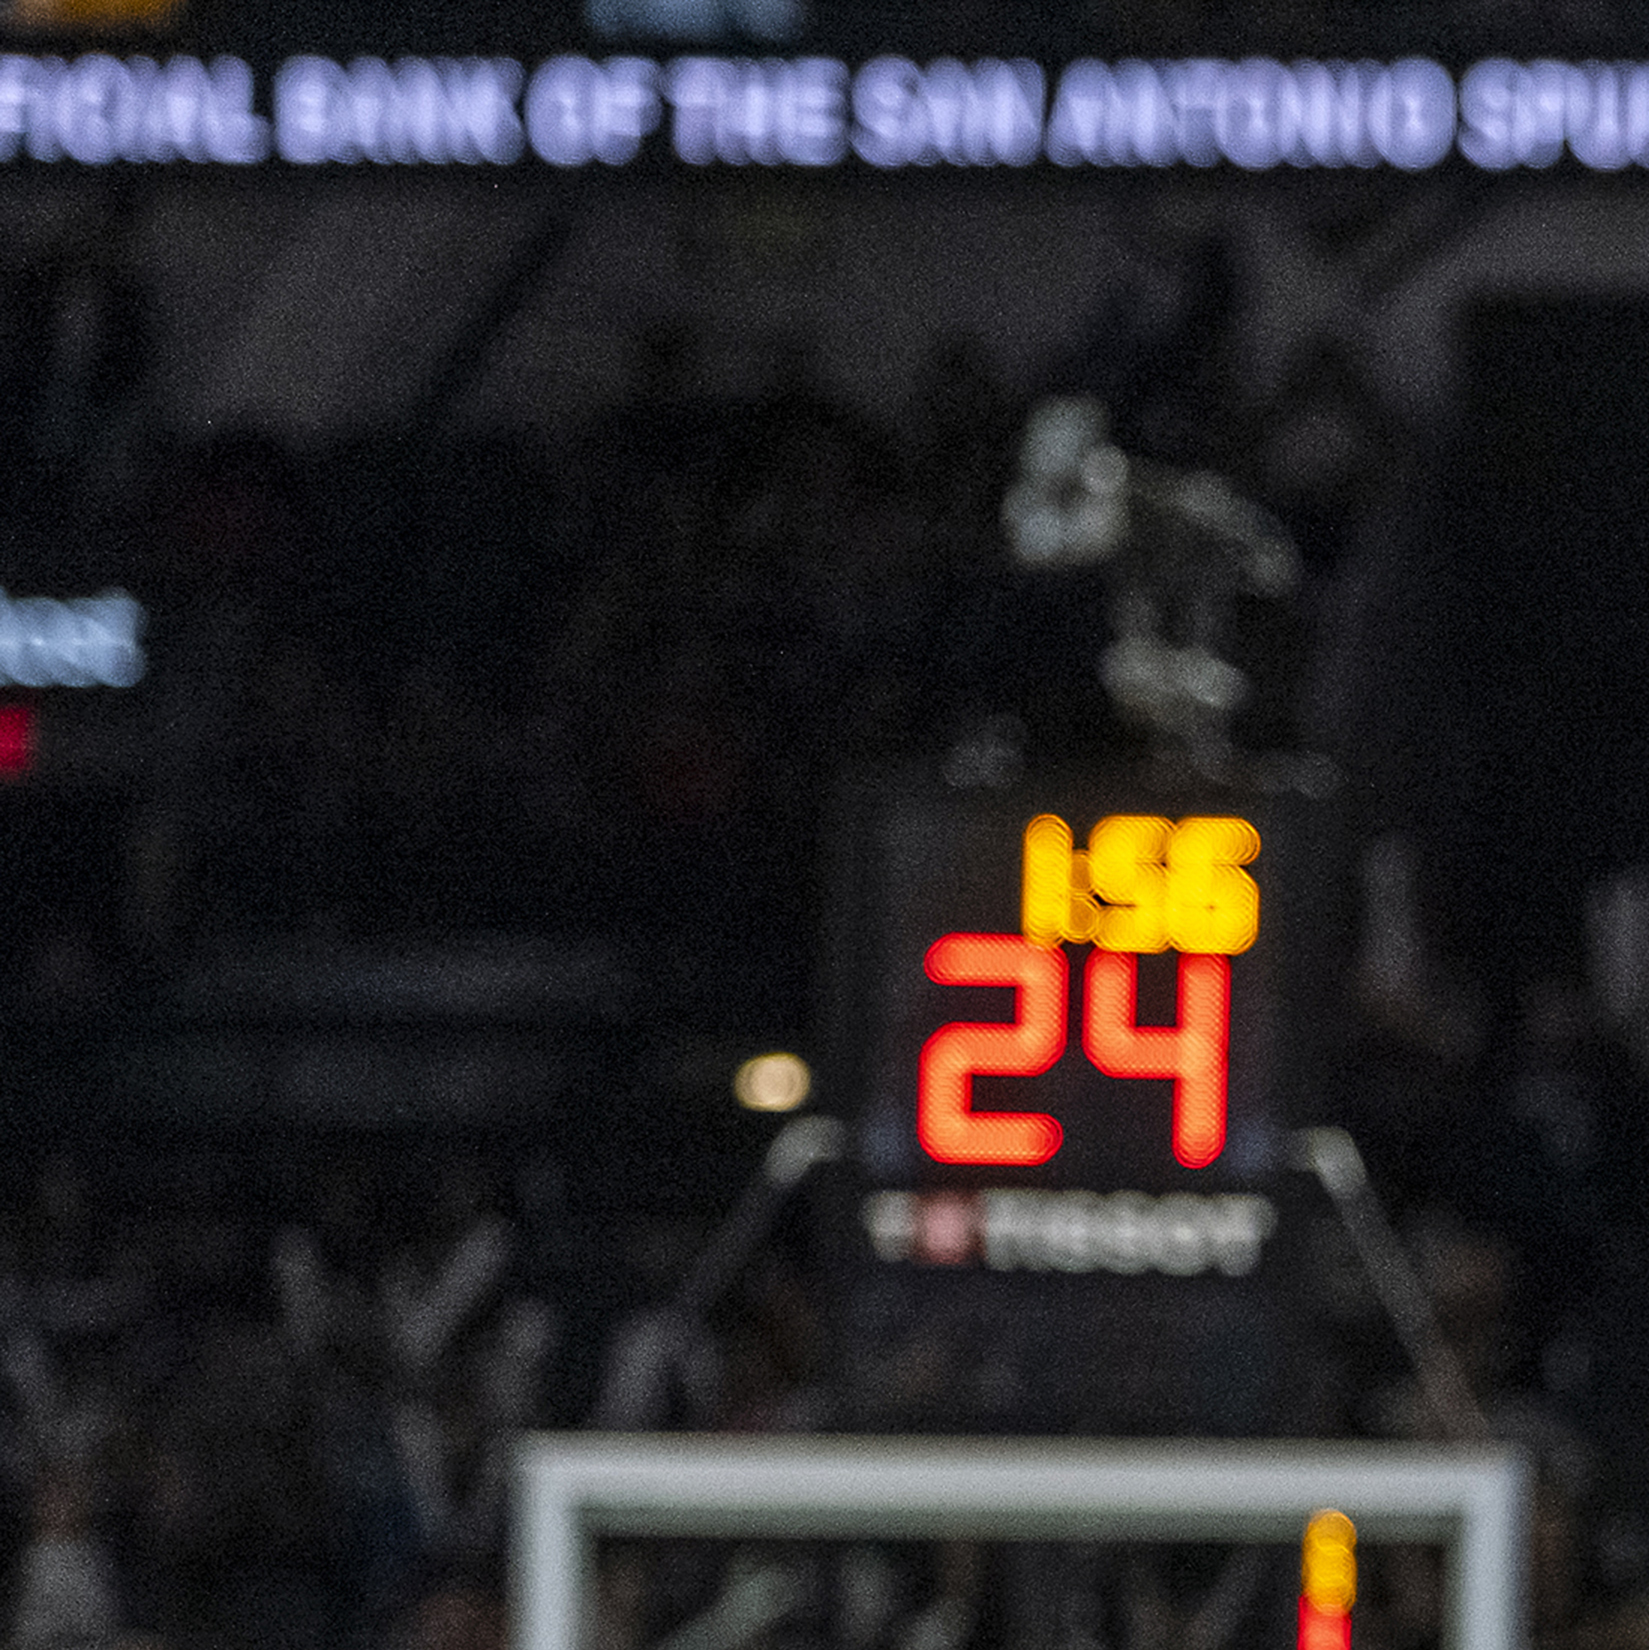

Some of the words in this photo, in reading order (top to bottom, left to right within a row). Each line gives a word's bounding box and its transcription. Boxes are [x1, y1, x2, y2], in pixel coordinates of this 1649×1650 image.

[274, 55, 525, 166] BANK
[525, 55, 664, 167] OF
[661, 56, 850, 167] THE
[851, 55, 1046, 168] SAN
[1047, 57, 1456, 169] ANTONIO
[917, 930, 1232, 1168] 24
